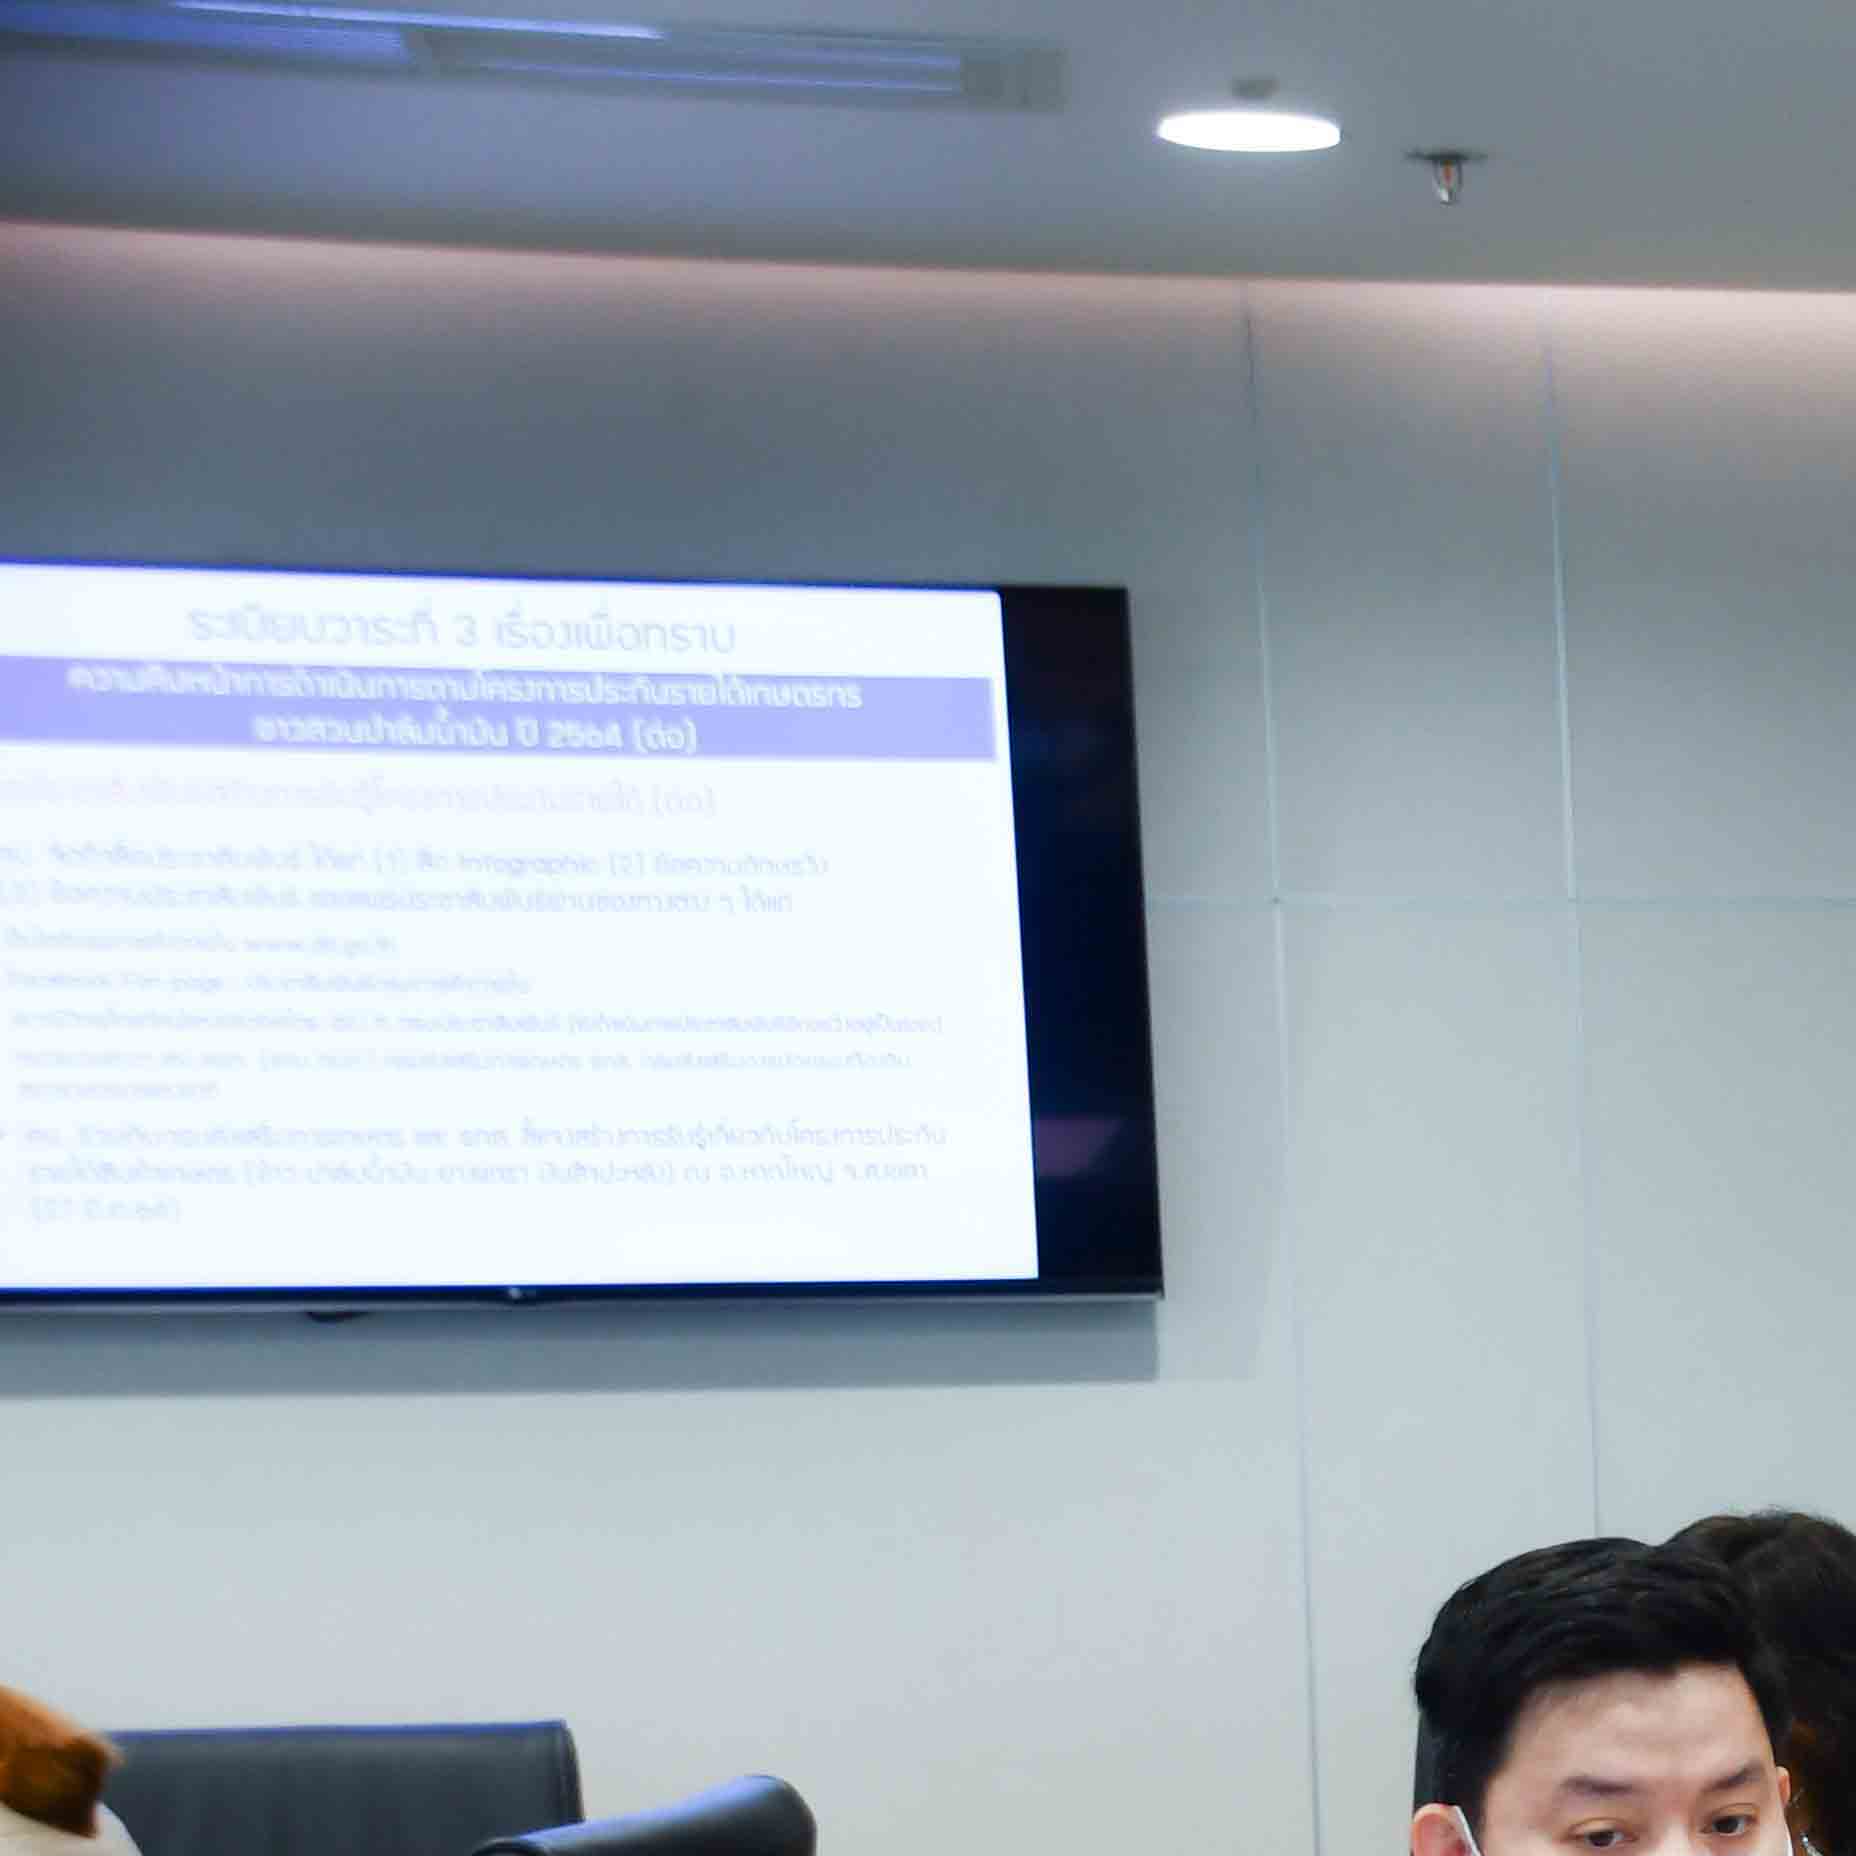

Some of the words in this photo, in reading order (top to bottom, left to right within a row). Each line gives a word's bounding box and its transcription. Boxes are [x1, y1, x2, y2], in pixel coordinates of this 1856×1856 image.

[451, 613, 478, 647] 3
[495, 600, 736, 655] เรื่องเพื่อทราบ
